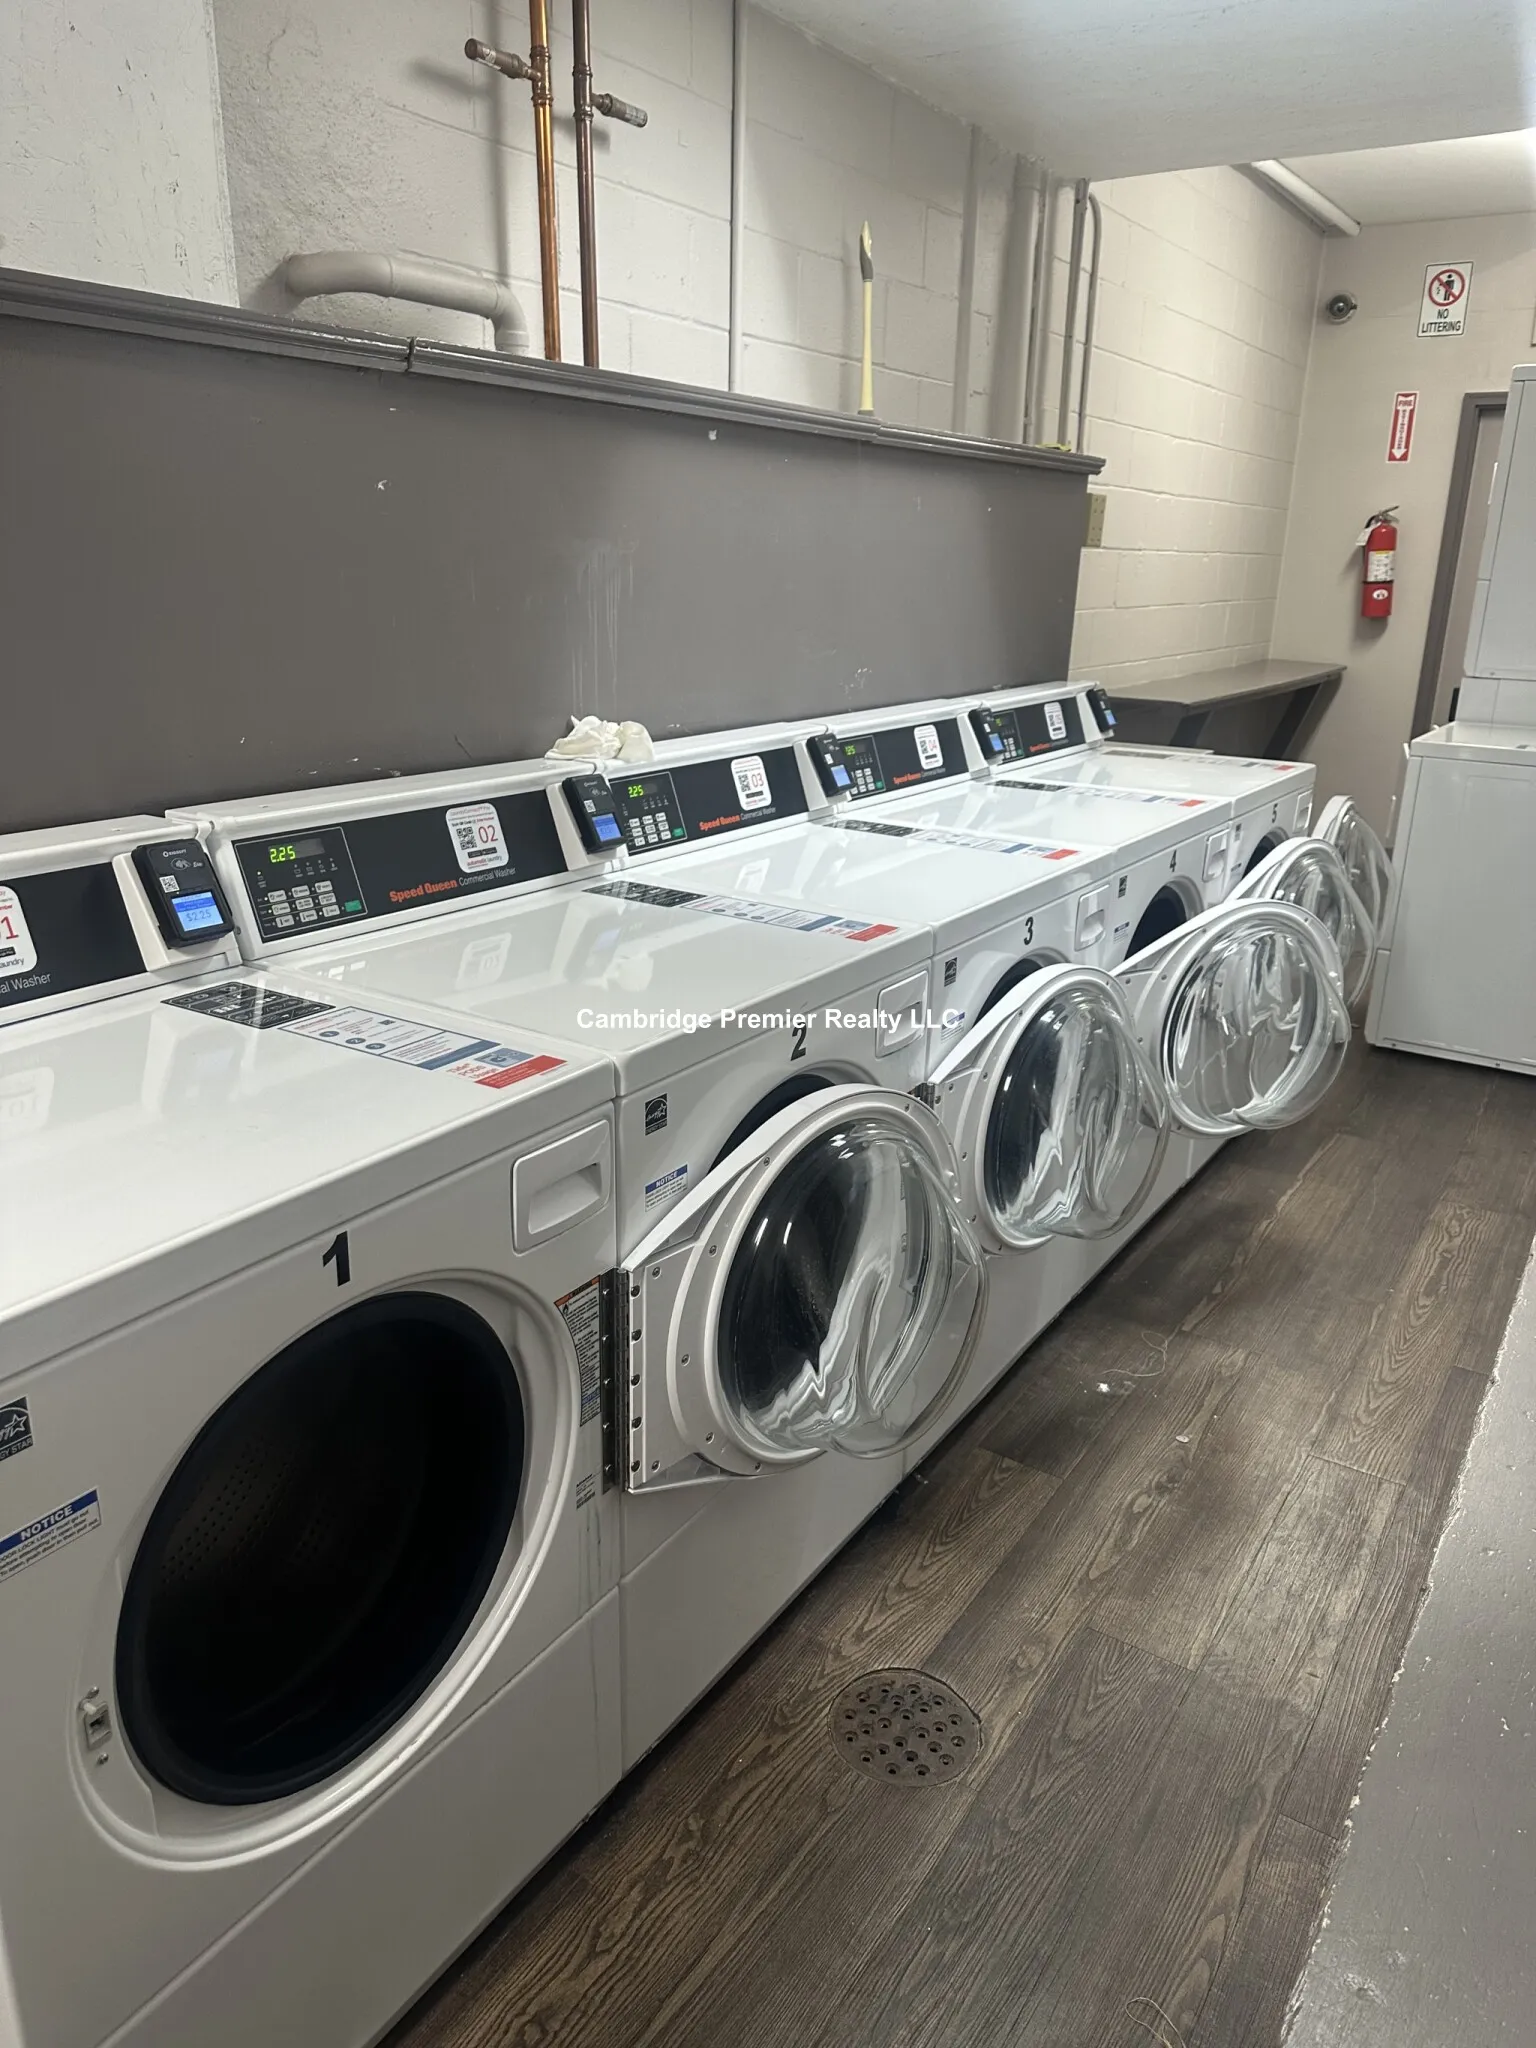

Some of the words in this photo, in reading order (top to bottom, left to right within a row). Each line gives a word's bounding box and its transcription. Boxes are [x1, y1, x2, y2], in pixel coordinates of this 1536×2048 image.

[1437, 308, 1449, 320] NO
[1421, 320, 1461, 334] LITTERING
[1398, 399, 1413, 407] FIRE
[751, 772, 764, 788] 03
[699, 817, 720, 831] Speed
[720, 813, 740, 826] Queen
[1271, 803, 1278, 824] 5
[478, 825, 498, 844] 02
[270, 845, 296, 863] 2.25
[1169, 849, 1178, 872] 4
[389, 885, 424, 903] Speed
[424, 879, 458, 893] Queen
[458, 872, 495, 886] Commercial
[494, 866, 516, 879] Washer
[1023, 916, 1034, 946] 3
[11, 973, 52, 990] Washer
[790, 1021, 807, 1061] 2
[655, 1170, 678, 1188] NOTICE
[323, 1230, 350, 1287] 1
[20, 1504, 74, 1541] NOTICE
